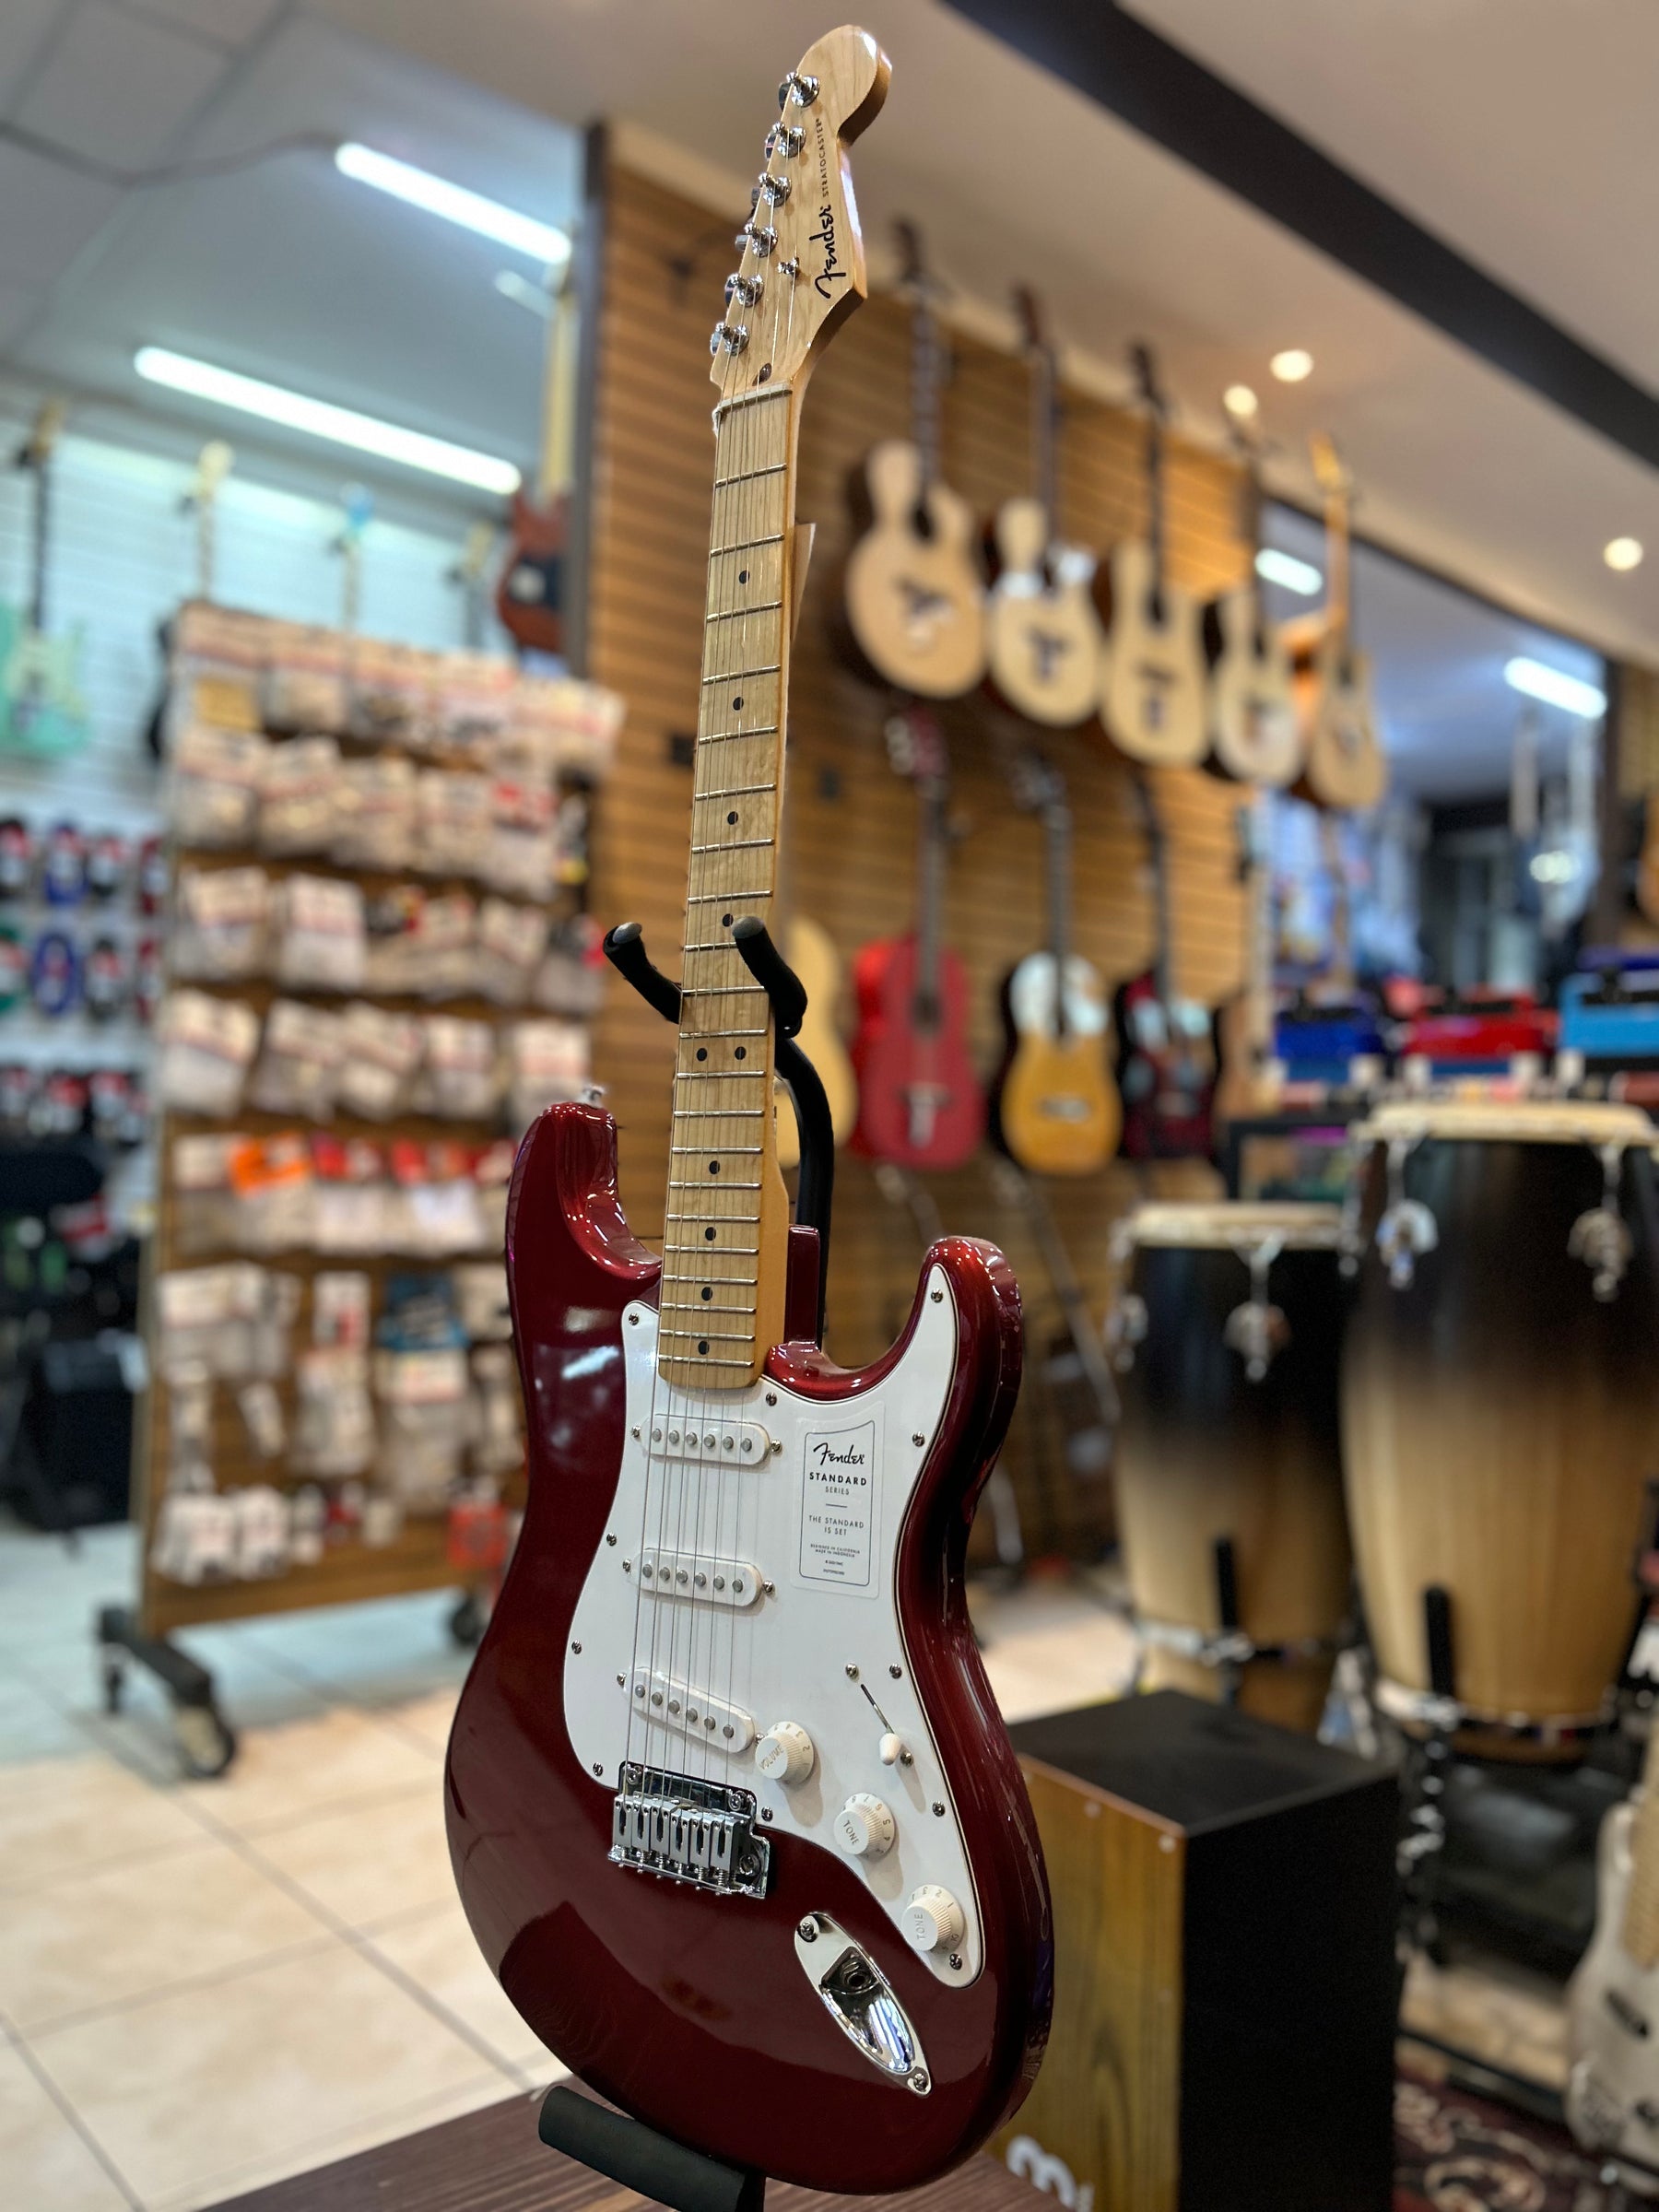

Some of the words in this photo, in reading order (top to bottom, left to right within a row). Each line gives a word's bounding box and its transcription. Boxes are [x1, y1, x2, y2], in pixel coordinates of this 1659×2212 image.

[816, 119, 829, 198] STRATOCASTER
[809, 204, 847, 300] Fender
[813, 1442, 865, 1465] Fender
[809, 1472, 866, 1486] STANDARD
[826, 1486, 850, 1495] SERIES
[809, 1515, 821, 1524] THE
[825, 1517, 865, 1529] STANDARD
[759, 1744, 783, 1770] VOLUME
[843, 1819, 859, 1845] TONE
[914, 1913, 925, 1940] TONE
